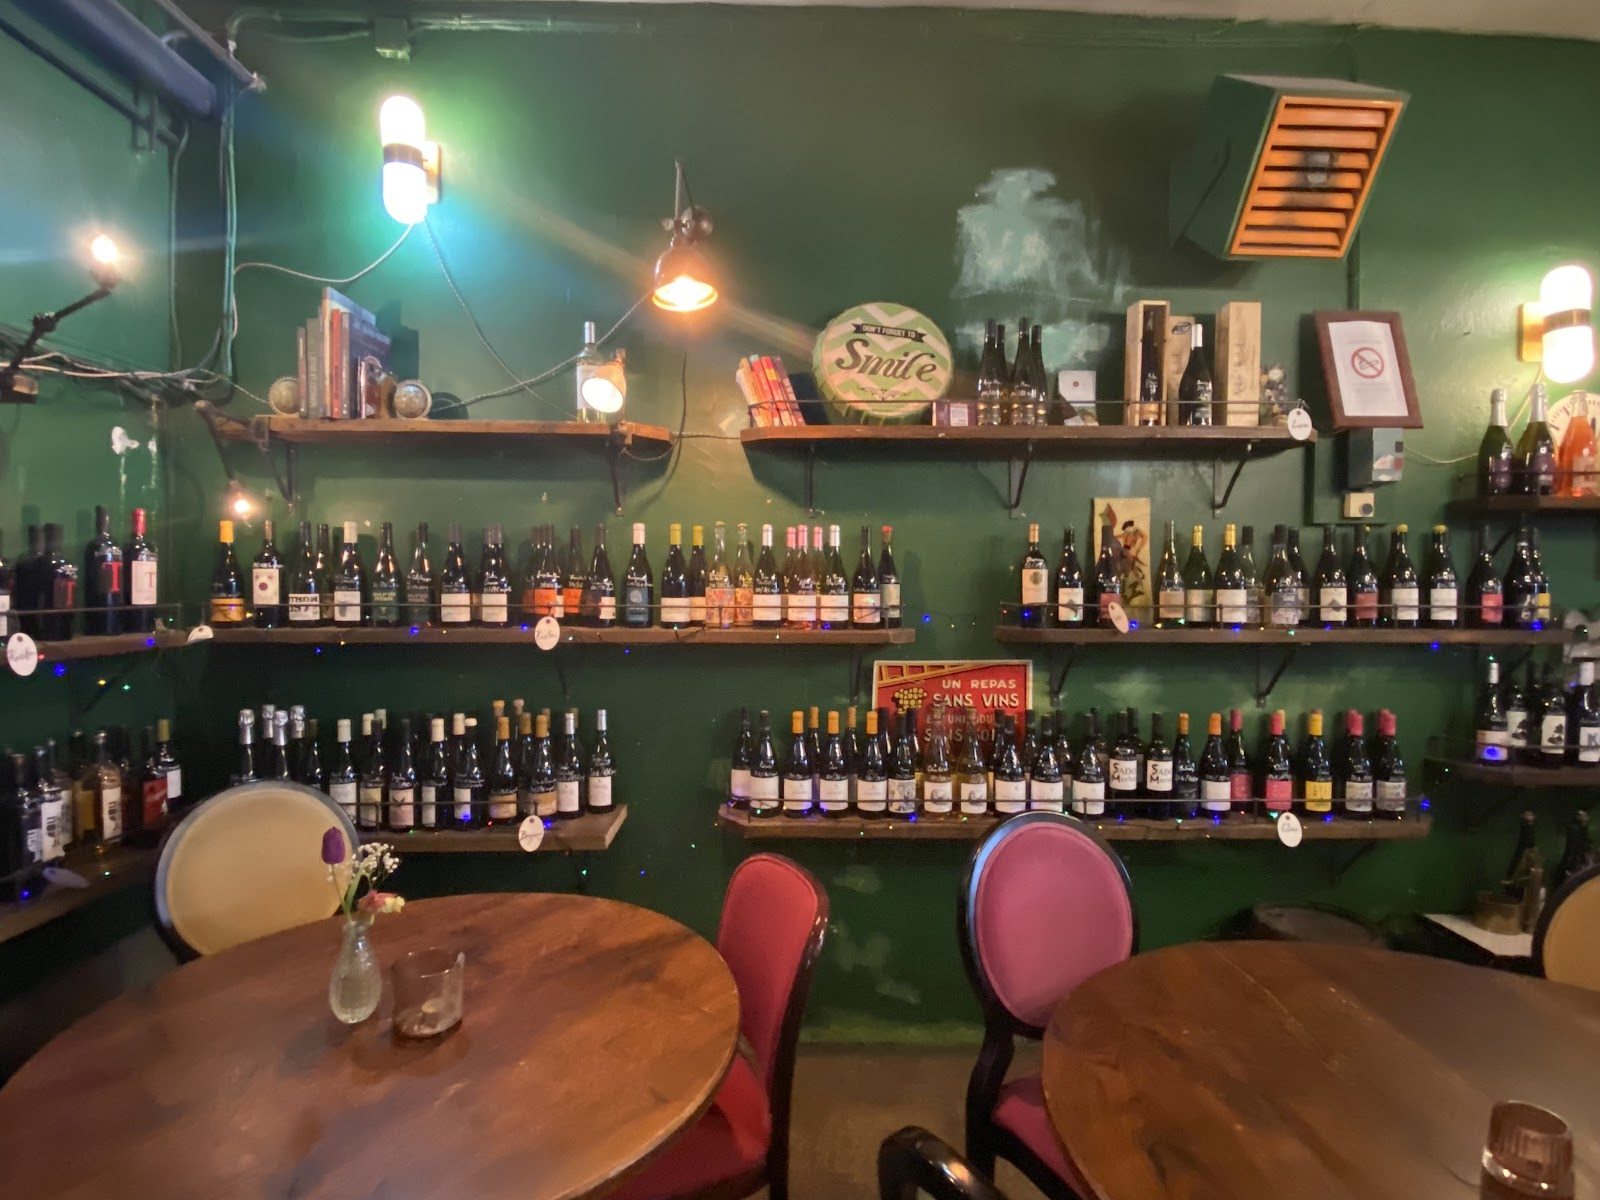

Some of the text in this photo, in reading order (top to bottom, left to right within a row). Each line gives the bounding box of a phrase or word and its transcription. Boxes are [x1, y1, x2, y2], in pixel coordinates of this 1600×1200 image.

[862, 324, 881, 333] DON'T
[881, 327, 905, 337] FORGET
[835, 338, 937, 382] Smile
[942, 679, 1017, 689] UN REPAS
[932, 692, 1020, 708] SANS VINS
